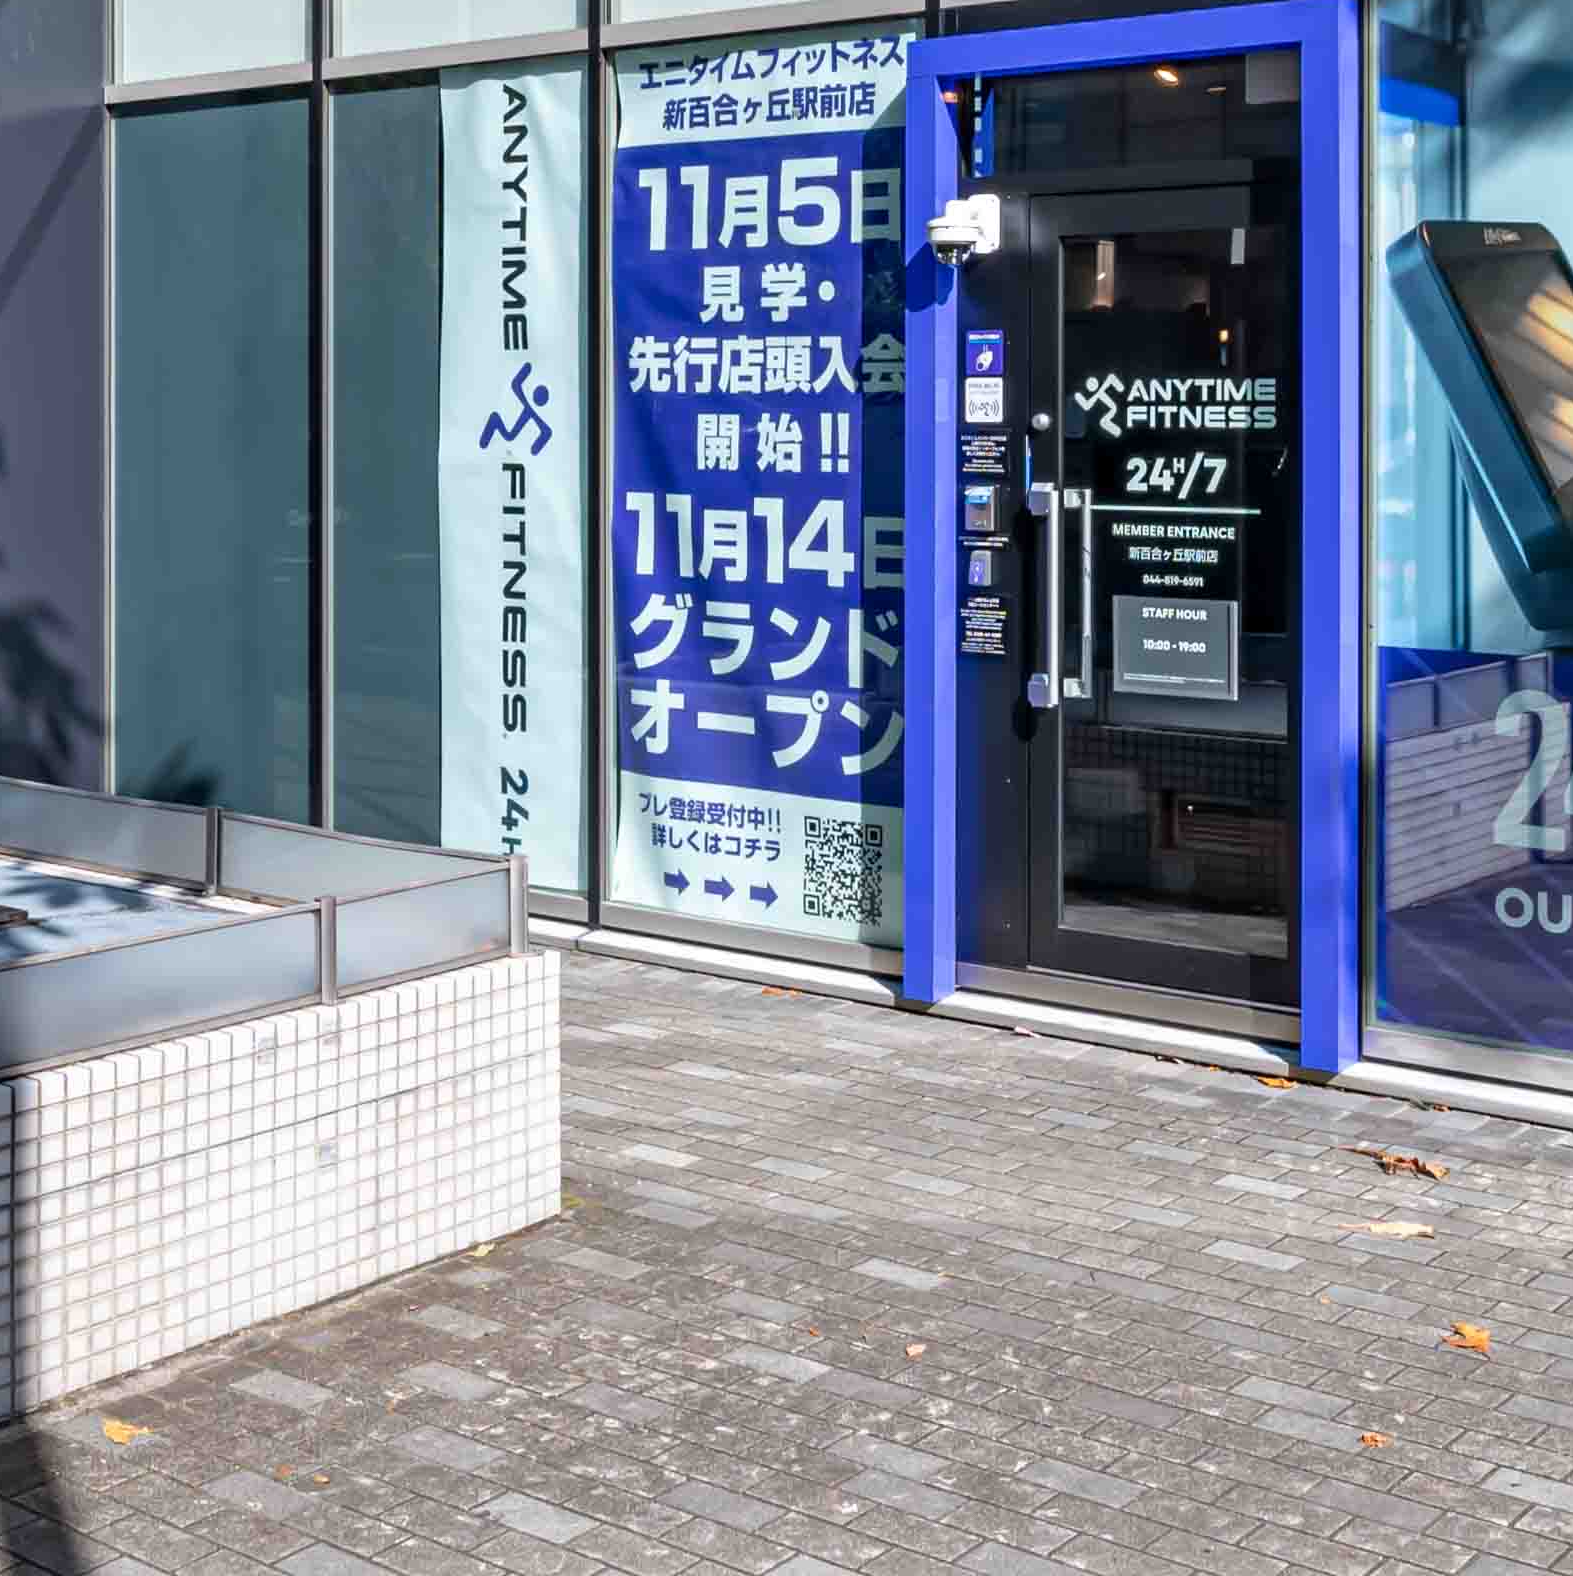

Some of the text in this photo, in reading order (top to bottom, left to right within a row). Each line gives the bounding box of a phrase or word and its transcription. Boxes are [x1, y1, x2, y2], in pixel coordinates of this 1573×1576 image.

[638, 35, 905, 90] エニタイムフィットネス
[662, 81, 877, 131] 新百合ヶ丘駅前店
[500, 83, 529, 352] ANYTIME
[638, 156, 902, 252] 11月5日
[628, 333, 906, 394] 先行店頭入会
[1126, 377, 1276, 402] ANYTIME
[1126, 404, 1276, 429] FITNESS
[625, 491, 906, 589] 11月14日
[1112, 523, 1235, 540] MEMBER ENTRANCE
[500, 462, 528, 733] FITNESS
[1142, 607, 1207, 621] STAFF HOUR
[629, 592, 900, 688] グランド
[1143, 640, 1171, 652] 10:00
[629, 678, 906, 776] オープン
[651, 823, 781, 862] 詳しくはコチラ
